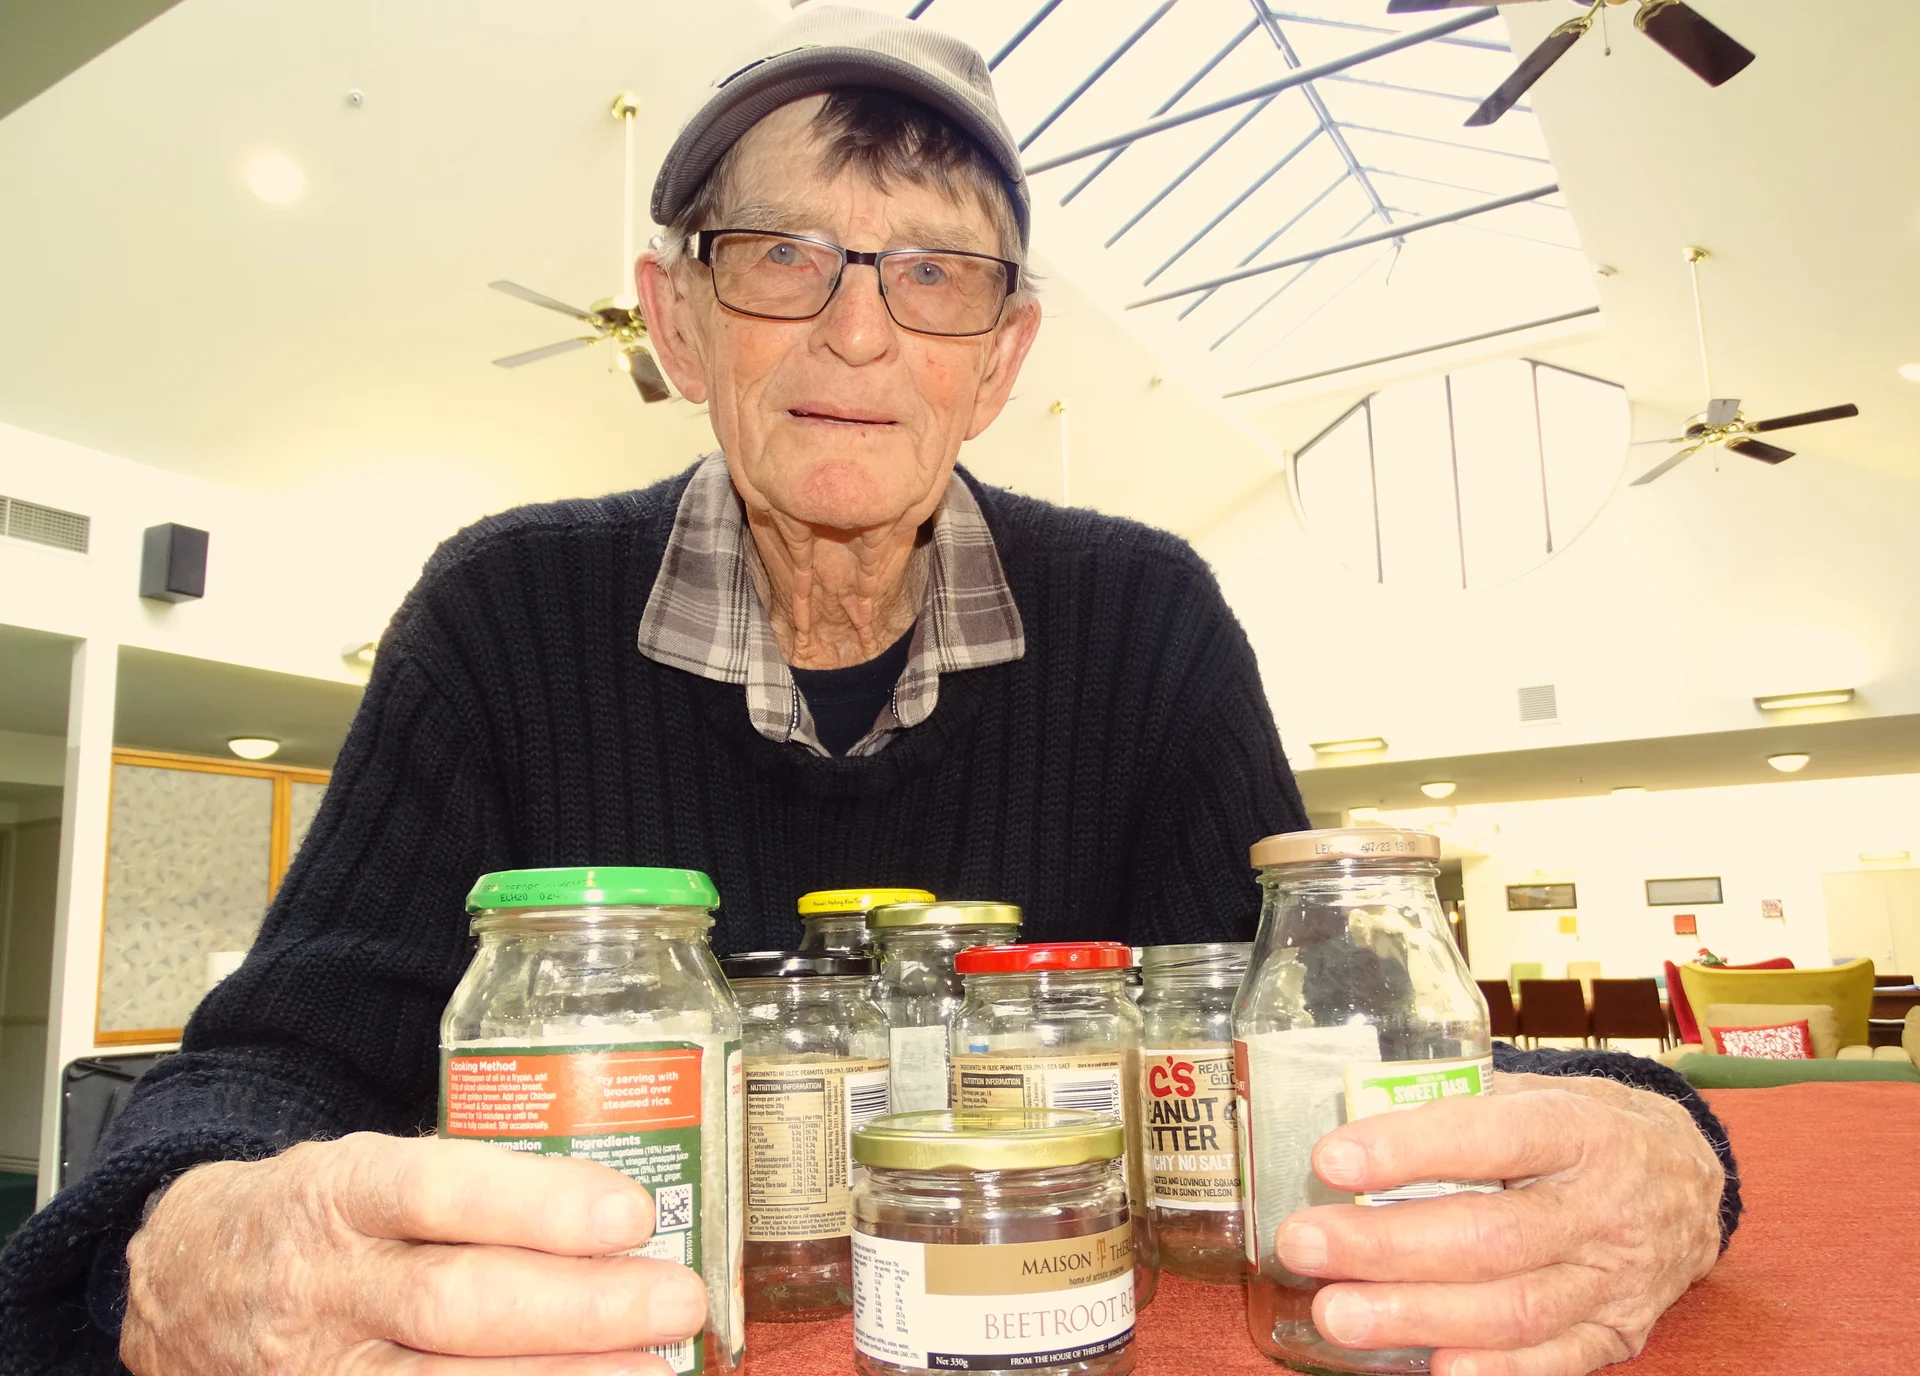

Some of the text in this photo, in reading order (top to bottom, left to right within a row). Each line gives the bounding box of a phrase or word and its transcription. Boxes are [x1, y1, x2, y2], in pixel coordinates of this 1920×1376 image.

[451, 1060, 516, 1073] Cooking Method
[512, 1074, 533, 1083] frypan,
[535, 1073, 548, 1081] add
[616, 1074, 655, 1085] serving
[658, 1071, 678, 1081] with
[985, 1077, 1021, 1085] INFORMATION
[498, 1083, 520, 1091] chicken
[522, 1083, 544, 1091] breast,
[603, 1085, 672, 1097] broccoli over
[750, 1082, 822, 1092] NUTRITION INFORMATION
[1393, 1082, 1439, 1103] SWEET
[1441, 1077, 1471, 1097] BASIL
[502, 1092, 514, 1100] Add
[515, 1094, 528, 1102] your
[530, 1092, 556, 1100] Chicken
[481, 1102, 492, 1110] Sour
[512, 1102, 524, 1110] and
[525, 1102, 550, 1110] simmer
[602, 1097, 672, 1110] steamed rice.
[483, 1112, 504, 1120] minutes
[513, 1112, 526, 1120] until
[499, 1121, 509, 1129] Stir
[510, 1121, 549, 1130] occasionally.
[571, 1135, 641, 1149] Ingredients
[1151, 1125, 1220, 1151] TTER
[481, 1139, 542, 1151] formation
[591, 1151, 609, 1160] sugar,
[611, 1147, 644, 1159] vegetables
[644, 1144, 661, 1156] (16%)
[625, 1152, 688, 1168] vinegar, pineapple juice
[1151, 1153, 1234, 1172] CHY NO SALT
[656, 1163, 681, 1171] thickener
[1168, 1177, 1179, 1185] AND
[1180, 1177, 1212, 1187] LOVINGLY
[1172, 1188, 1178, 1196] IN
[1180, 1188, 1202, 1196] SUNNY
[1204, 1189, 1232, 1197] NELSON
[1021, 1251, 1092, 1276] MAISON
[1093, 1271, 1108, 1281] artistic
[1109, 1266, 1125, 1277] preserves
[985, 1288, 1134, 1340] BEETROOT RE
[1010, 1344, 1105, 1366] FROM THE HOUSE OF THERESE
[936, 1357, 968, 1368] Net 330g
